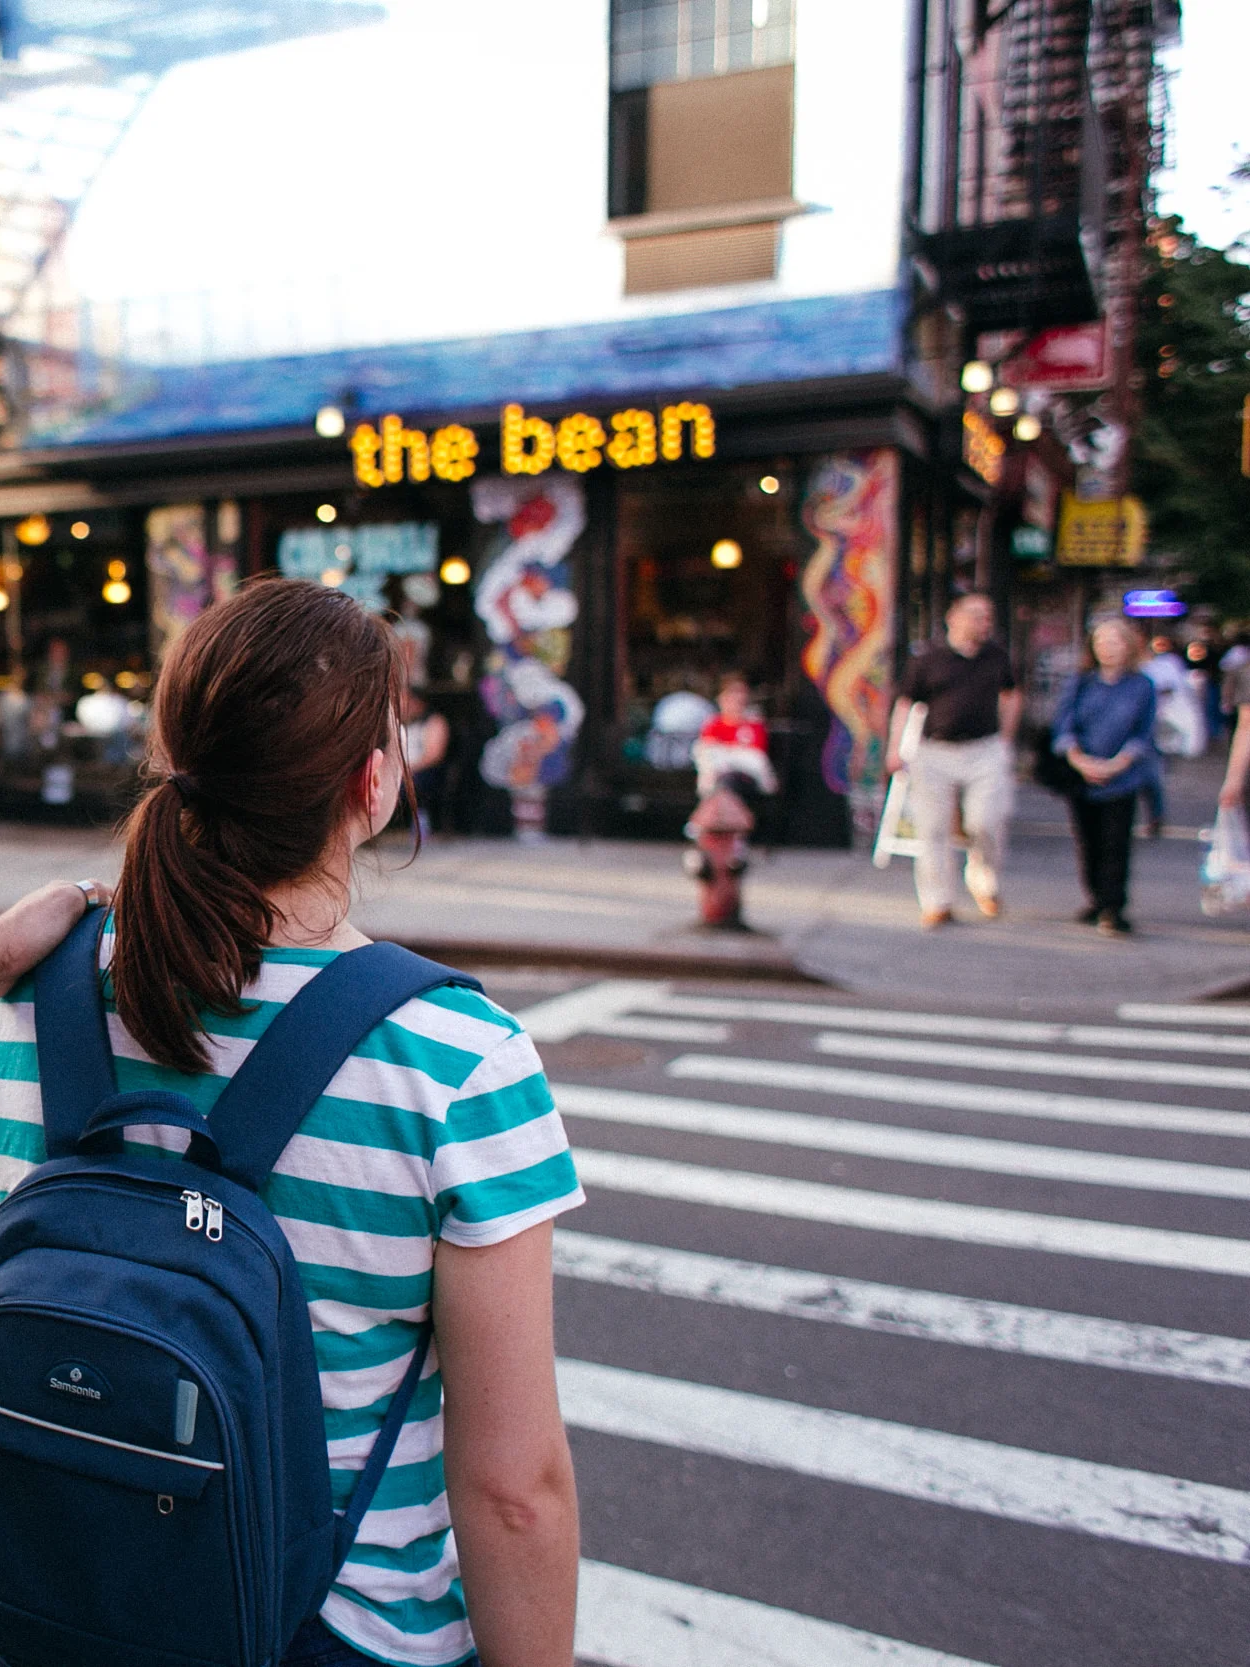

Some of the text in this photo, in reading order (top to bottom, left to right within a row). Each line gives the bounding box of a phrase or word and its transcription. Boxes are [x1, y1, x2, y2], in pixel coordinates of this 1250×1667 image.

[350, 402, 716, 487] the bean
[50, 1378, 101, 1399] Samsonite
